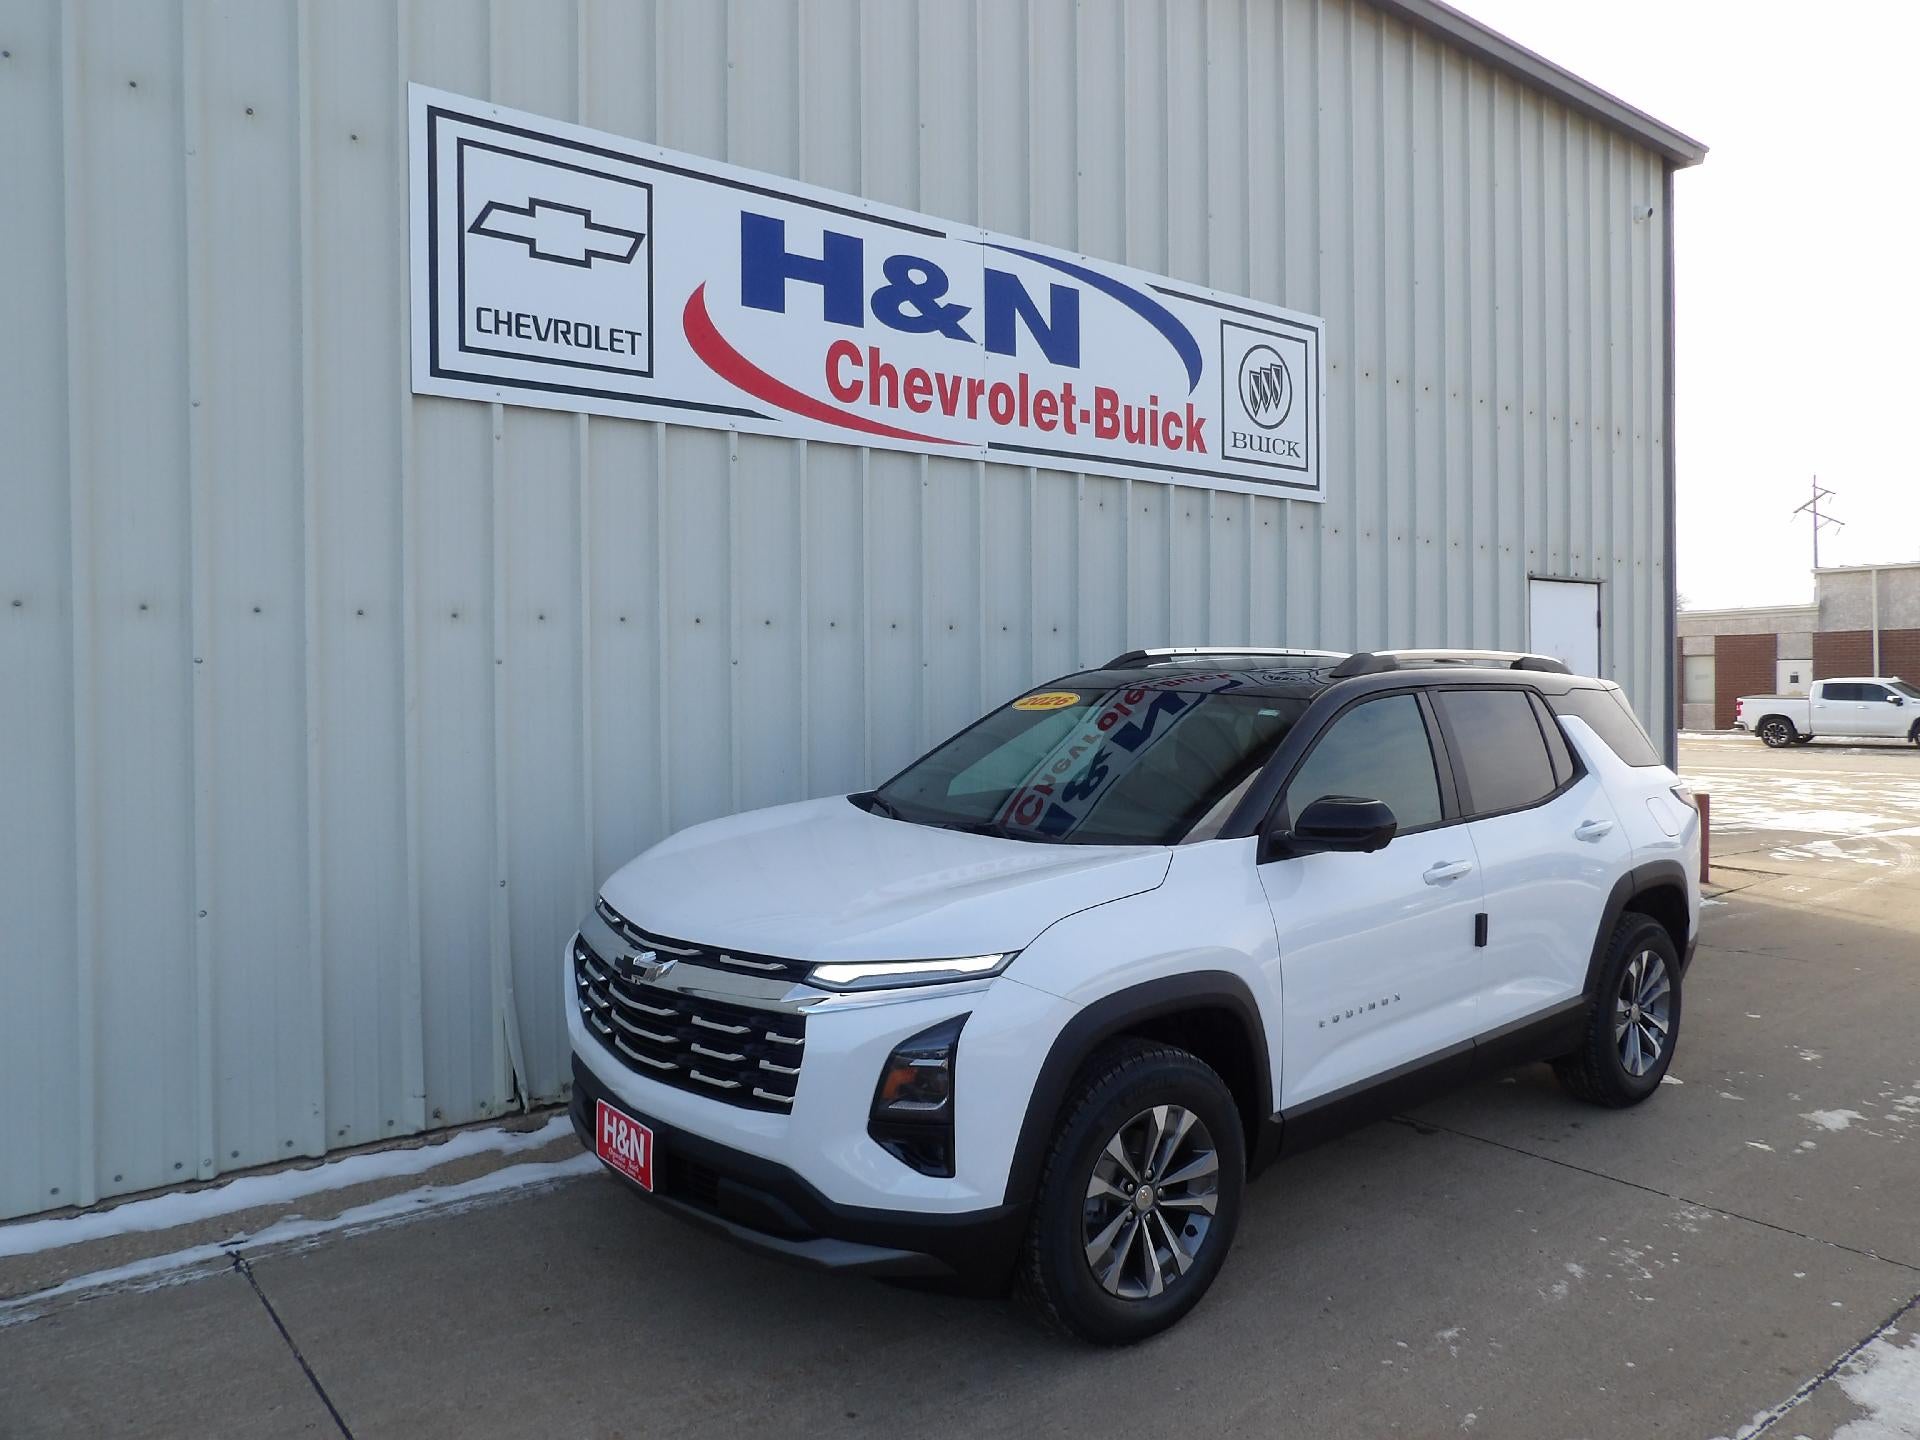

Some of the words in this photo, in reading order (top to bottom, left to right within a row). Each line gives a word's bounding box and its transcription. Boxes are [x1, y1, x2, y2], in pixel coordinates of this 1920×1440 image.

[741, 210, 1080, 369] H&N
[476, 306, 642, 356] CHEVROLET
[825, 339, 1208, 455] Chevrolet-Buick
[1231, 431, 1301, 458] BUICK
[603, 1110, 645, 1168] H&N
